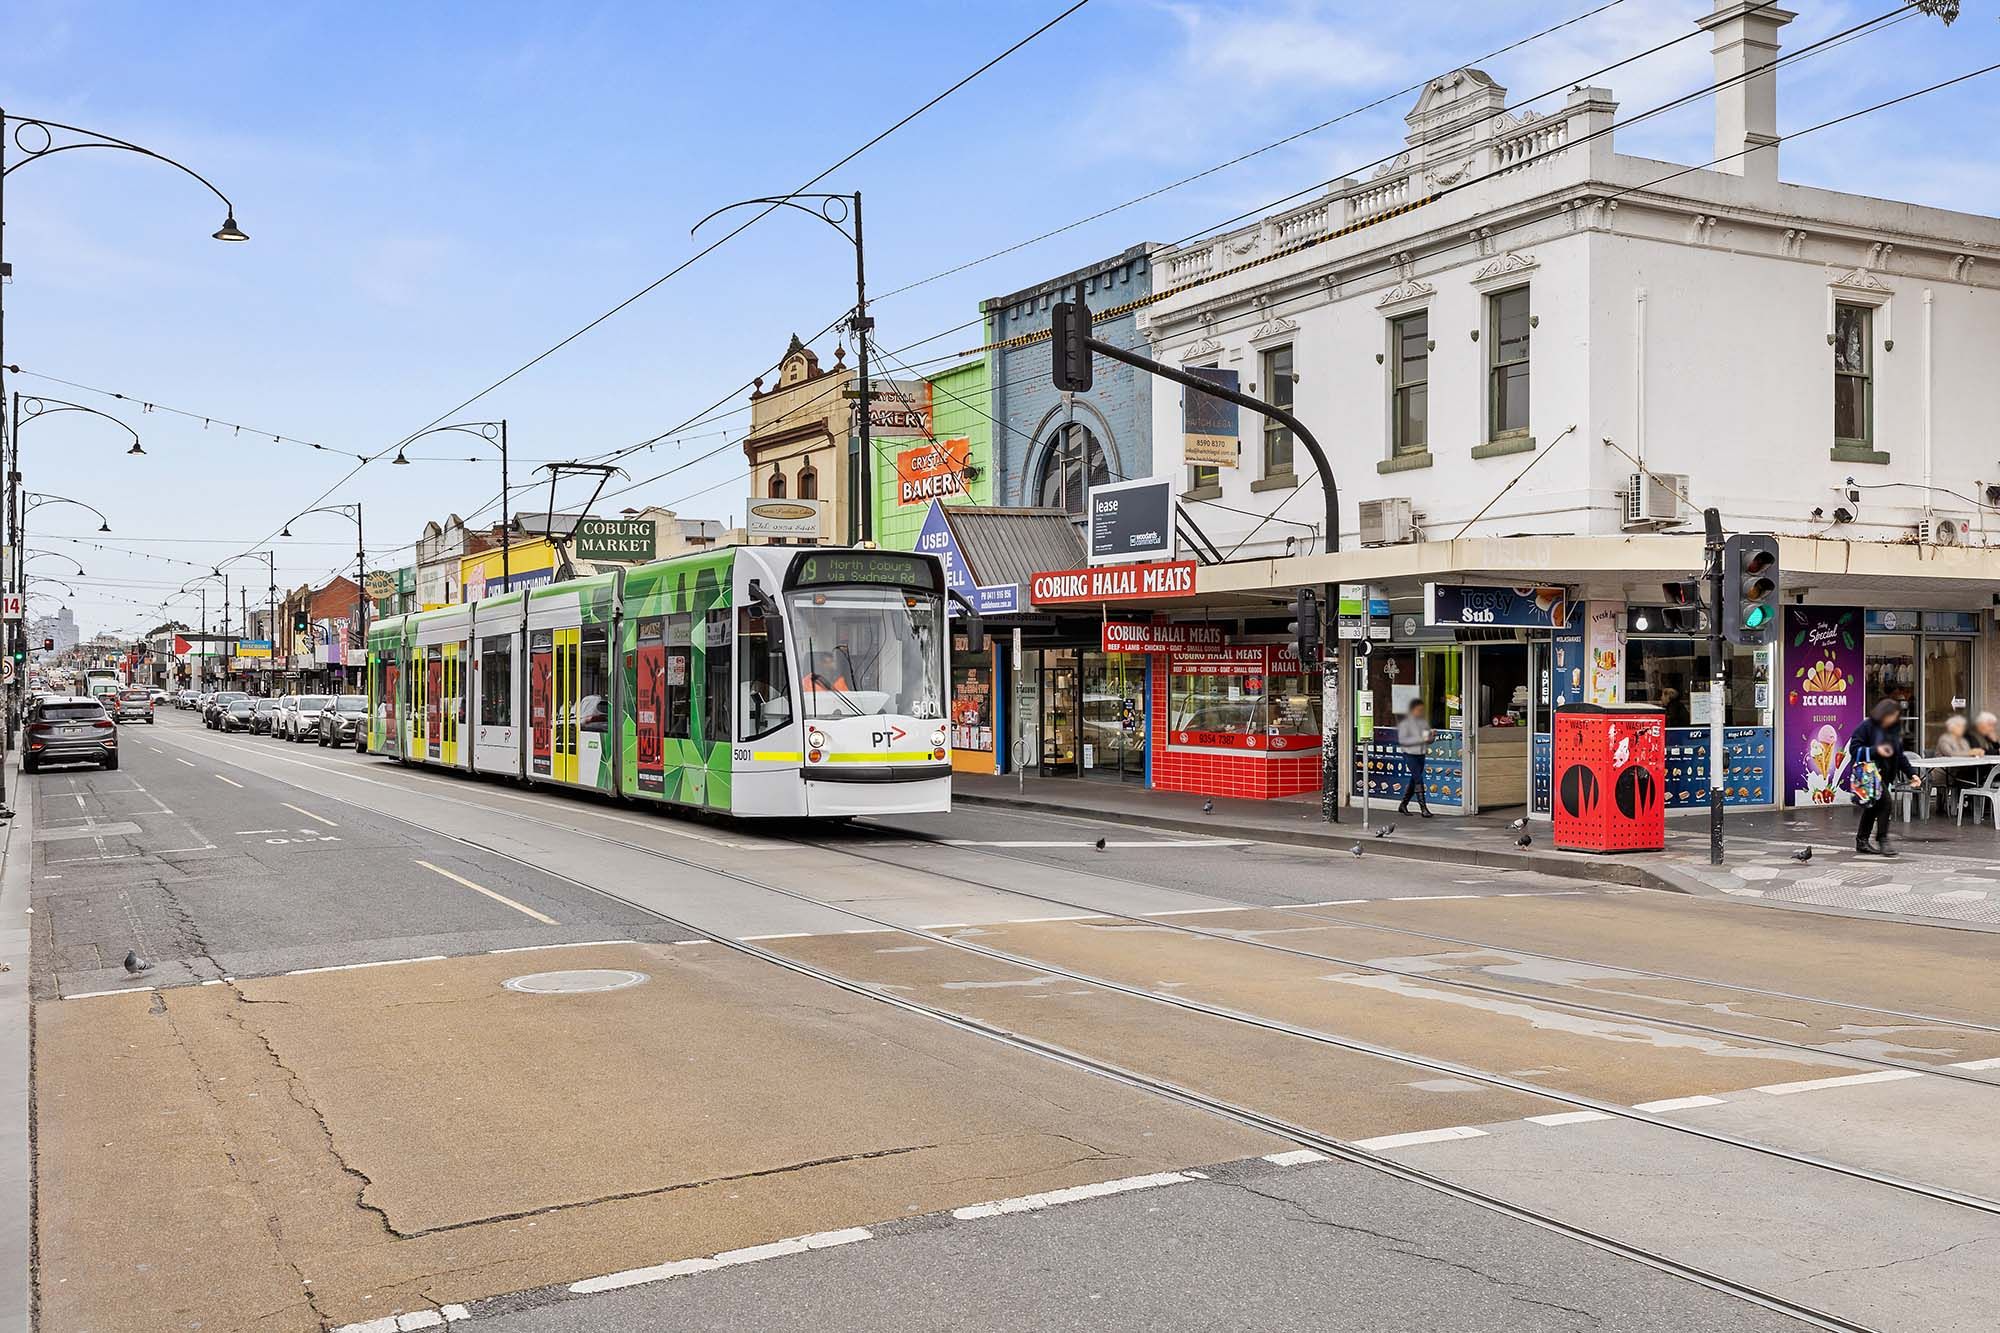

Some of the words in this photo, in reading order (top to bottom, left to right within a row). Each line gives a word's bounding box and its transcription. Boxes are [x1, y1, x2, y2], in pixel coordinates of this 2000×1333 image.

[1196, 439, 1211, 447] 8590
[902, 470, 963, 503] BAKERY
[1096, 499, 1119, 513] lease
[583, 522, 650, 536] COBURG
[581, 539, 651, 552] MARKET
[922, 531, 949, 550] USED
[830, 559, 864, 570] North
[869, 559, 912, 571] Coburg
[852, 572, 895, 583] Sydney
[900, 572, 915, 583] Rd
[1034, 573, 1088, 599] COBURG
[1092, 569, 1138, 596] HALAL
[1143, 566, 1191, 592] MEATS
[4, 598, 20, 614] 14
[1461, 588, 1515, 617] Tasty
[1462, 607, 1495, 623] Sub
[1107, 625, 1150, 641] COBURG
[1153, 626, 1186, 642] HALAL
[1189, 627, 1221, 643] MEATS
[1808, 623, 1838, 647] Special
[1107, 643, 1121, 651] BEEF
[1125, 643, 1140, 651] LAMB
[1170, 644, 1183, 652] GOAT
[1235, 649, 1263, 660] MEATS
[1271, 661, 1297, 672] HALAL
[1541, 670, 1549, 705] OPEN
[1803, 695, 1817, 706] ICE
[1817, 695, 1847, 706] CREAM
[912, 701, 941, 716] 5001
[1813, 714, 1837, 722] DELICIOUS
[1570, 721, 1589, 730] WASTE
[1199, 734, 1216, 744] 9354
[1218, 735, 1235, 745] 7387
[733, 749, 752, 761] 5001
